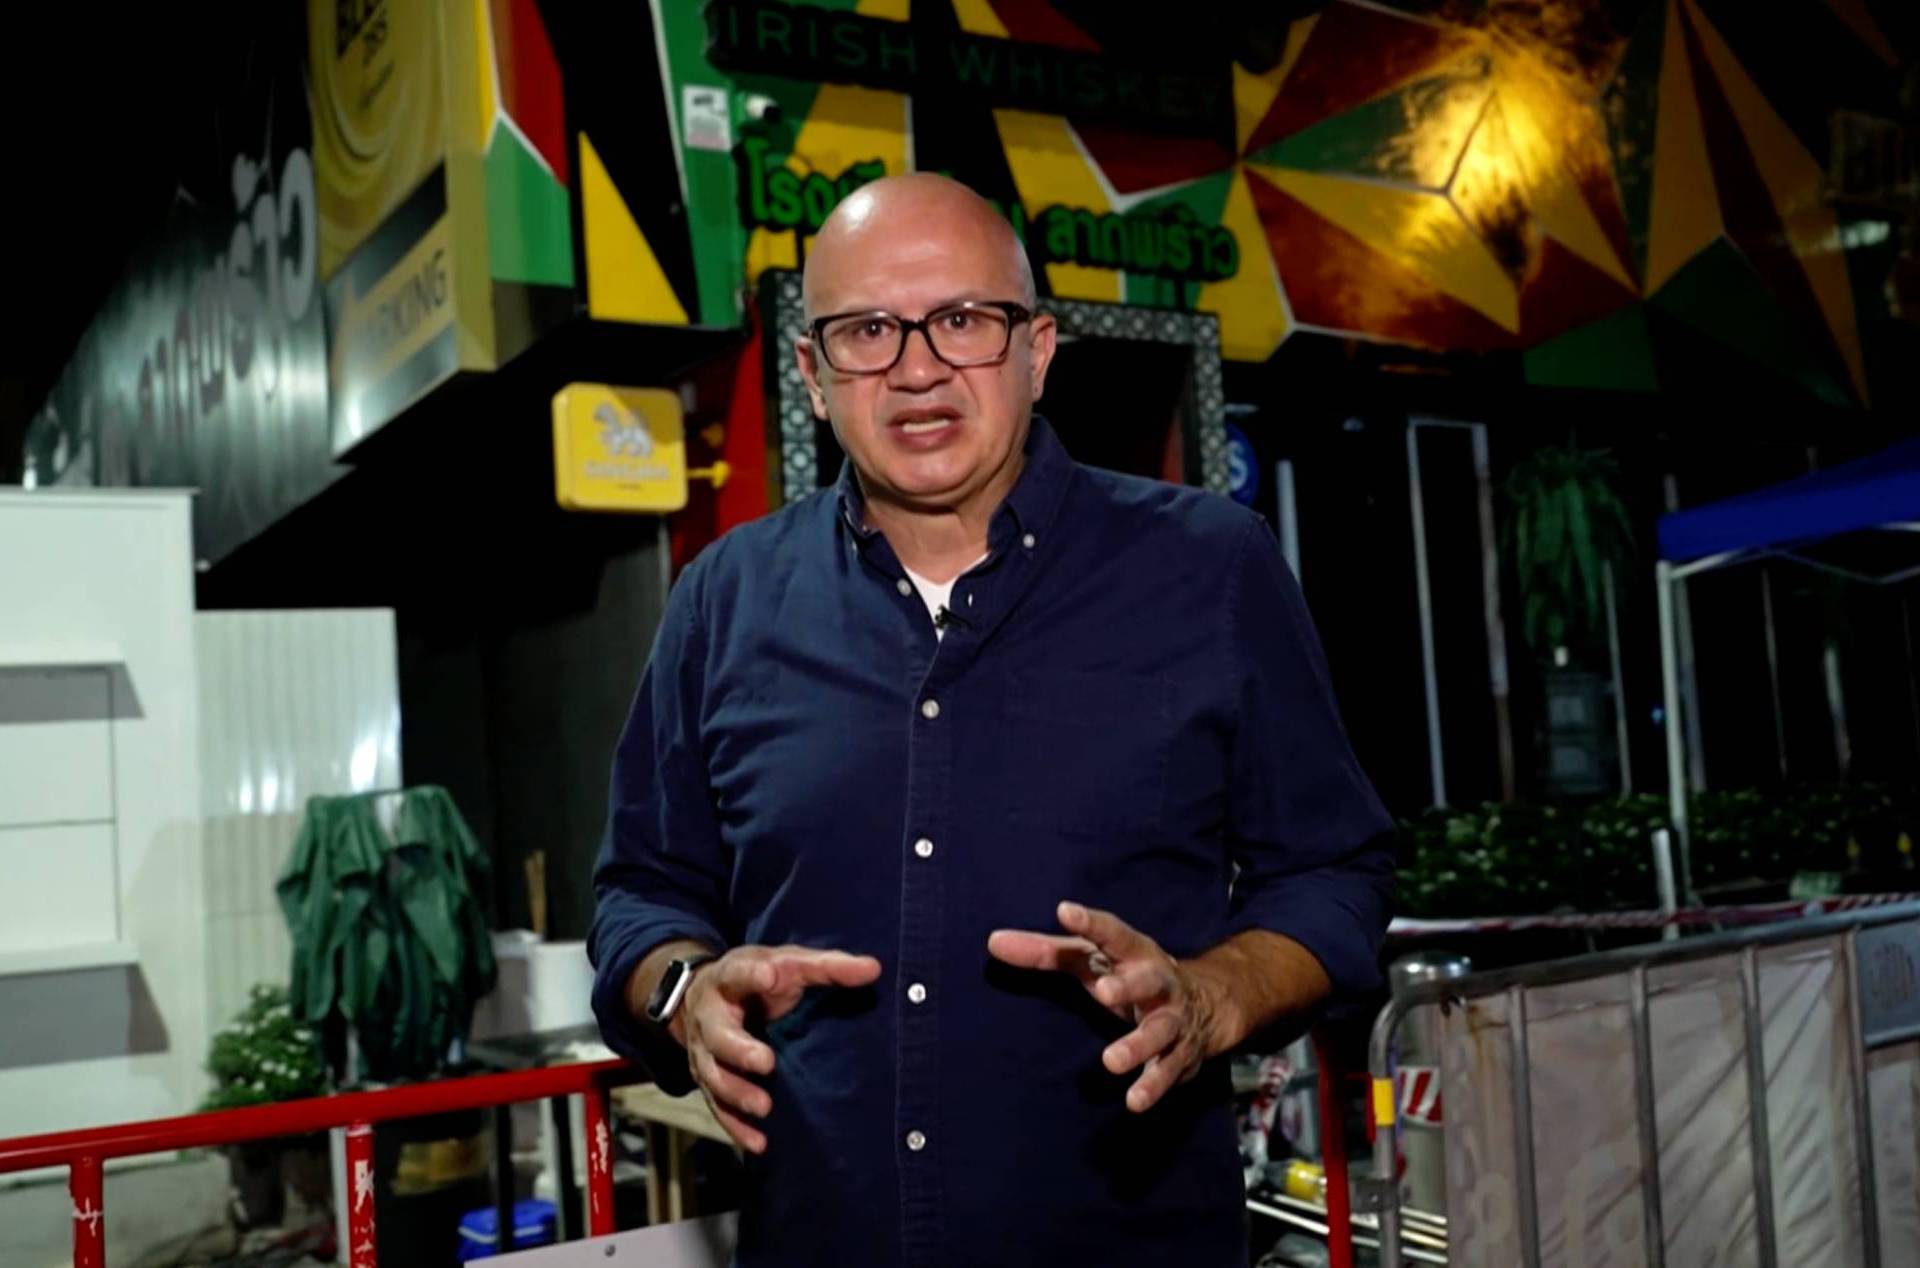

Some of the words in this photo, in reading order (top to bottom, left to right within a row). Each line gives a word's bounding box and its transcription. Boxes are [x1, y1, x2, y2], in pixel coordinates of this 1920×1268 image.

[728, 9, 918, 76] IRISH
[950, 39, 1222, 117] WHISKEY
[1046, 203, 1240, 278] ลาดพร้าว
